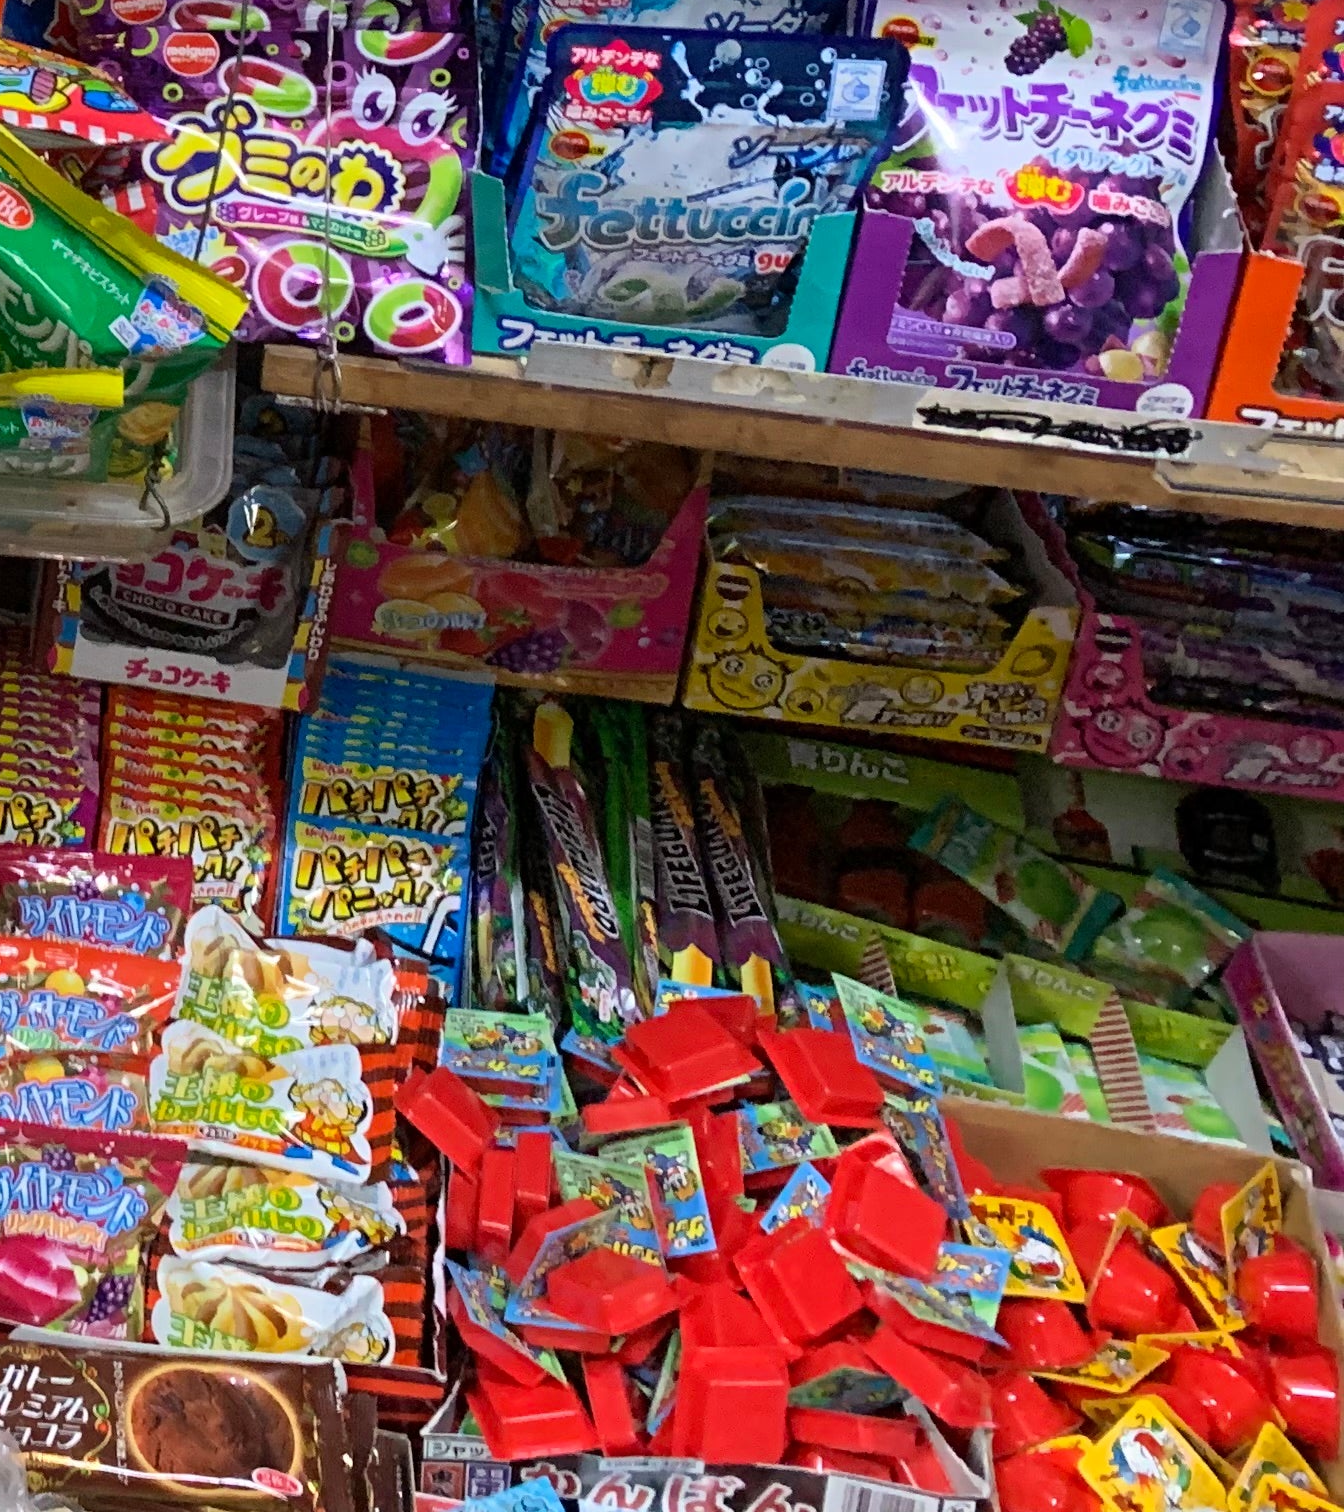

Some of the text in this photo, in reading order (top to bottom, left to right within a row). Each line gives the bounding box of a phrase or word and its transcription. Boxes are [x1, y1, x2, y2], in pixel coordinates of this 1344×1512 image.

[570, 46, 661, 69] アルデンテな
[881, 171, 996, 196] アルデンテな
[50, 236, 132, 307] ヤマザキビスケット
[121, 591, 227, 626] CHOCO CAKE
[124, 657, 232, 692] チョコケーキ
[301, 772, 442, 817] パチパチ
[111, 815, 244, 858] パチパチ
[294, 840, 434, 891] パチパチ
[19, 894, 172, 953] ダイヤモンド
